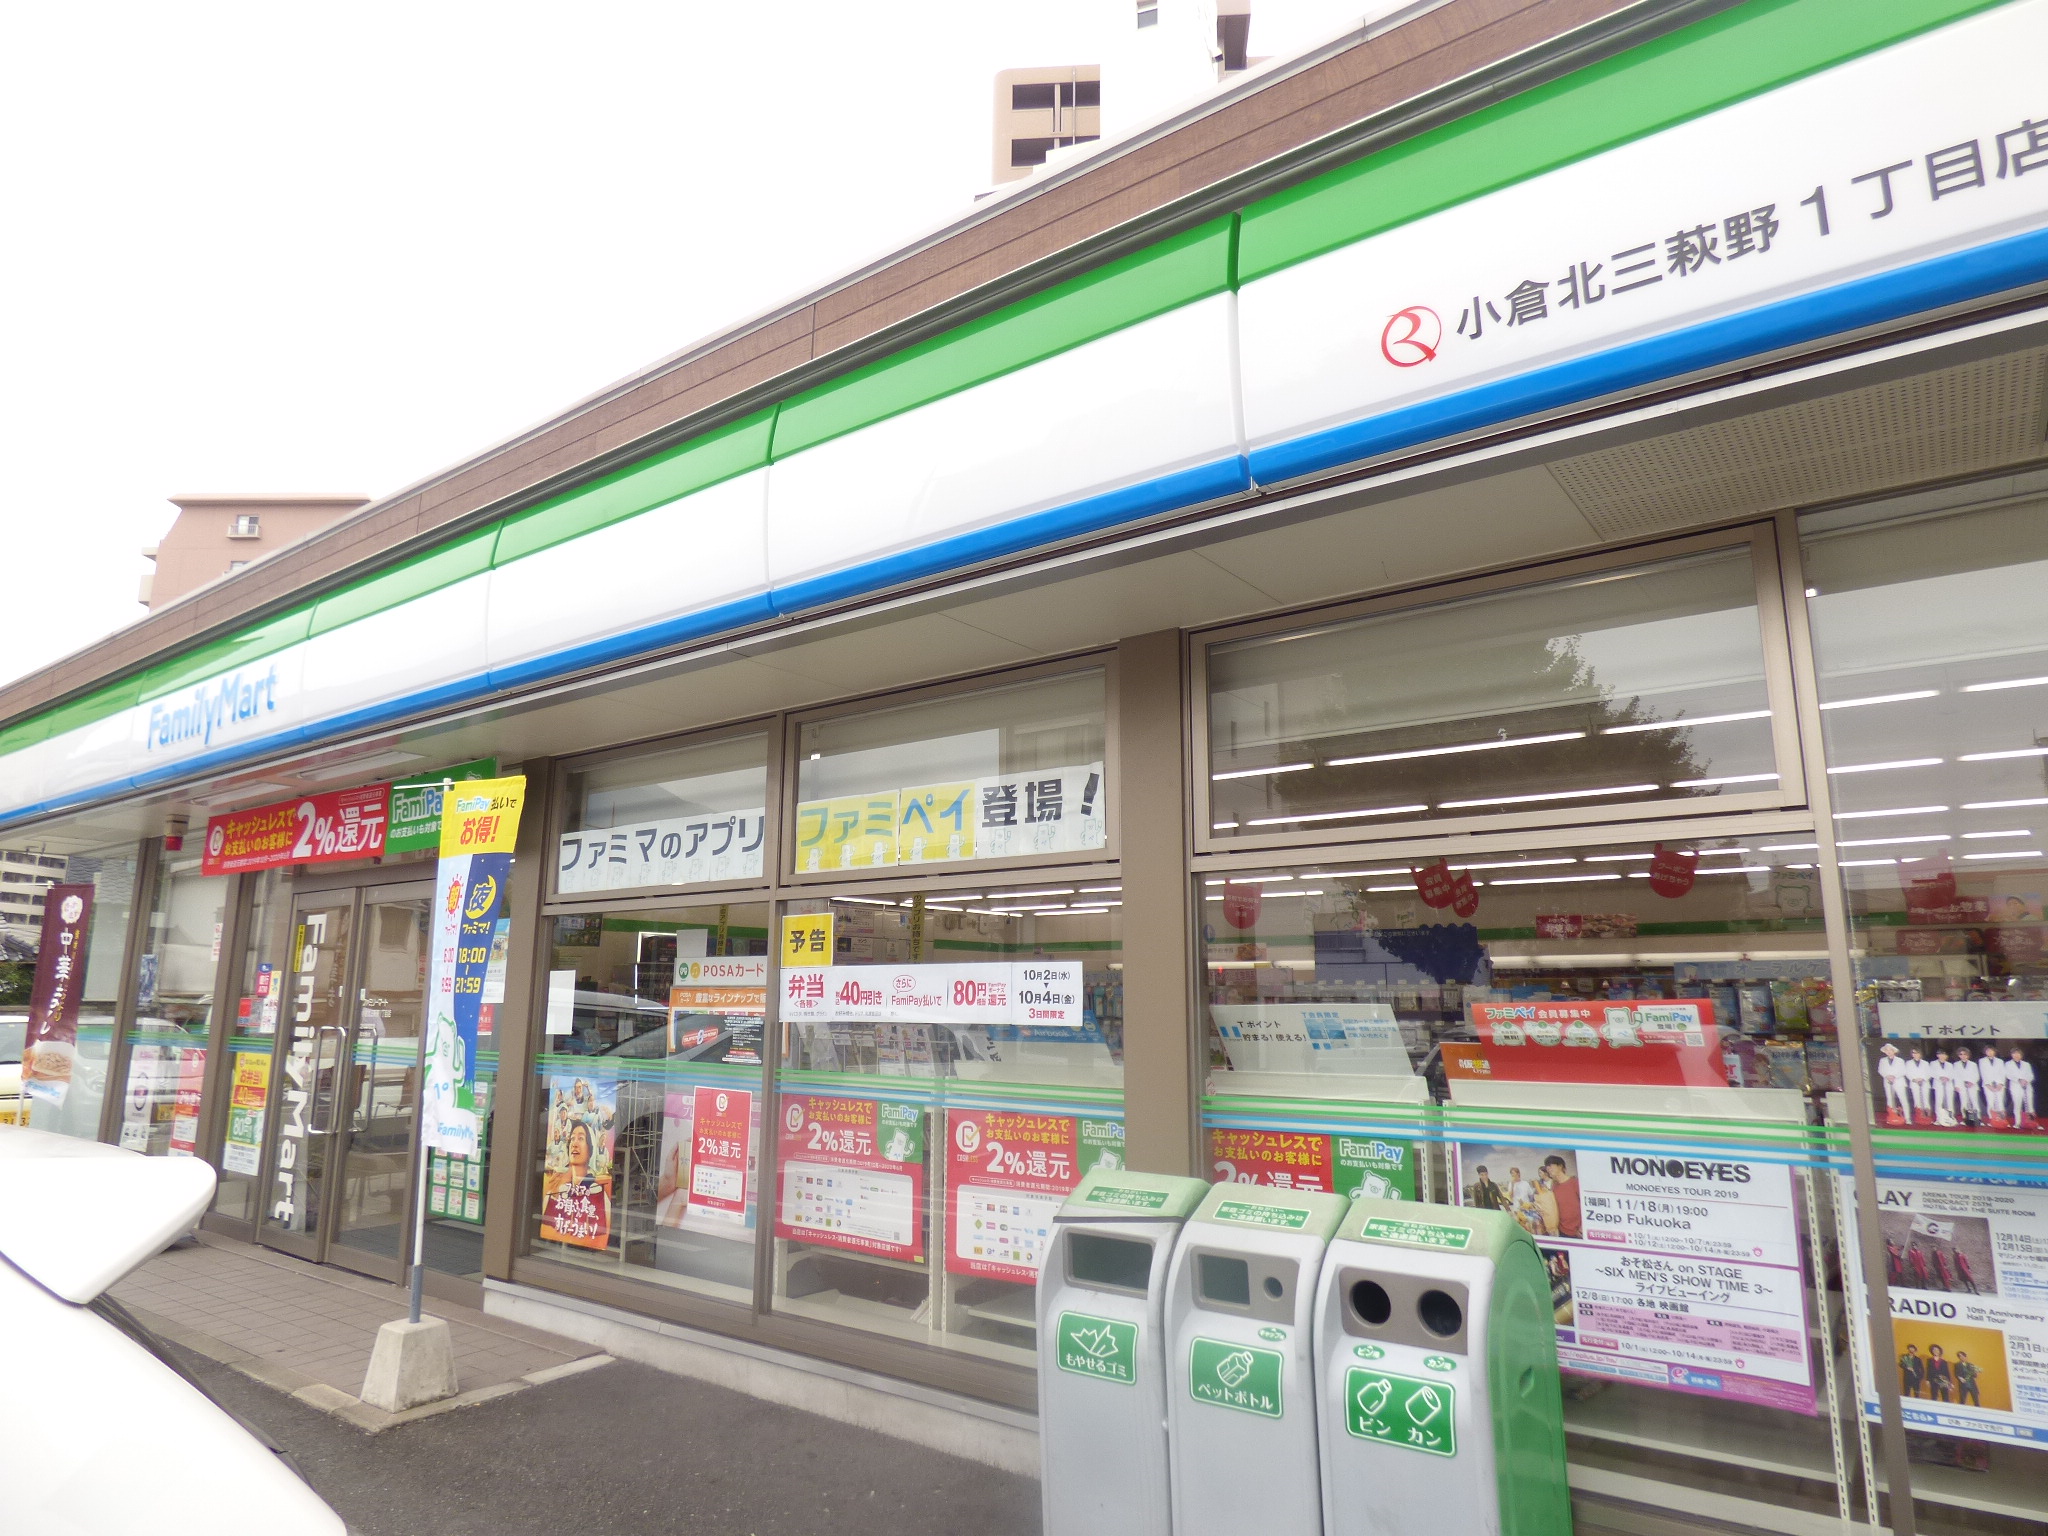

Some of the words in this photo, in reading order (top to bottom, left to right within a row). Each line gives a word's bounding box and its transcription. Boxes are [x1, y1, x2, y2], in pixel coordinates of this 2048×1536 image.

[147, 664, 277, 749] FamilyMart
[392, 788, 443, 823] FamiPa
[226, 808, 296, 839] キャッシュレスで
[292, 801, 385, 859] 2%還元
[460, 816, 500, 845] お得!
[224, 832, 294, 857] お支払いのお客様に
[562, 815, 765, 872] ファミマのアプリ
[789, 929, 826, 953] 予告
[457, 946, 487, 963] 18:00
[703, 963, 764, 977] POSAカード
[1023, 969, 1071, 981] 10月2日(水)
[455, 976, 481, 993] 21:59
[788, 974, 824, 999] 弁当
[895, 978, 912, 988] さらに
[840, 981, 883, 1006] 40円引き
[891, 995, 942, 1007] FamiPay払いで
[988, 994, 1006, 1006] 還元
[1018, 991, 1075, 1005] 10月4日(金)
[1028, 1008, 1065, 1020] 3日間限定
[1485, 1006, 1536, 1019] ファミペイ
[1538, 1009, 1591, 1018] 会員募集中
[1645, 1012, 1693, 1022] FamiPay
[273, 913, 328, 1222] FamilyMart
[808, 1097, 873, 1114] キャッシュレスで
[881, 1104, 919, 1121] FamiPay
[808, 1110, 872, 1125] お支払いのお客様に
[985, 1112, 1071, 1133] キャッシュレスで
[807, 1121, 872, 1156] 2%還元
[986, 1129, 1070, 1145] お支払いのお客様に
[1082, 1120, 1125, 1139] FamiPa
[698, 1137, 741, 1159] 2%還元
[1212, 1129, 1323, 1152] キャッシュレスで
[1213, 1146, 1323, 1166] お支払いのお客様に
[1339, 1138, 1404, 1163] FamiPay
[986, 1141, 1071, 1180] 2%還元
[1340, 1159, 1404, 1171] のお支払いも対象です
[1091, 1190, 1164, 1203] 家庭ゴミの持ち込みは
[1625, 1183, 1680, 1195] MONOEYES
[1683, 1187, 1711, 1197] TOUR
[1714, 1189, 1739, 1199] 2019
[1972, 1195, 2016, 1204] 2019-2020
[1922, 1197, 1970, 1206] DEMOCRACY
[1220, 1206, 1304, 1222] 家庭ゴミの持ち込みは
[1586, 1209, 1622, 1225] Zepp
[1627, 1213, 1692, 1231] Fukuoka
[1677, 1205, 1709, 1217] 19:00
[1988, 1208, 2010, 1216] SUITE
[1368, 1223, 1466, 1240] 家庭ゴミの持ち込みは
[1620, 1256, 1673, 1273] おそ松さん
[1678, 1264, 1694, 1274] on
[1699, 1264, 1743, 1280] STAGE
[1628, 1270, 1668, 1283] MEN'S
[1672, 1274, 1712, 1288] SHOW
[1716, 1279, 1749, 1293] TIME
[1635, 1283, 1731, 1304] ライブビューイング
[1610, 1295, 1633, 1305] 17:00
[1636, 1298, 1656, 1309] 各地
[1659, 1301, 1690, 1313] 映画館
[1966, 1306, 1987, 1315] 10th
[1989, 1308, 2045, 1323] Anniversary
[1966, 1314, 1984, 1323] Hall
[1986, 1316, 2007, 1325] Tour
[1065, 1353, 1127, 1377] もやせるゴミ
[1198, 1383, 1274, 1410] ペットボトル
[1407, 1427, 1442, 1446] カン
